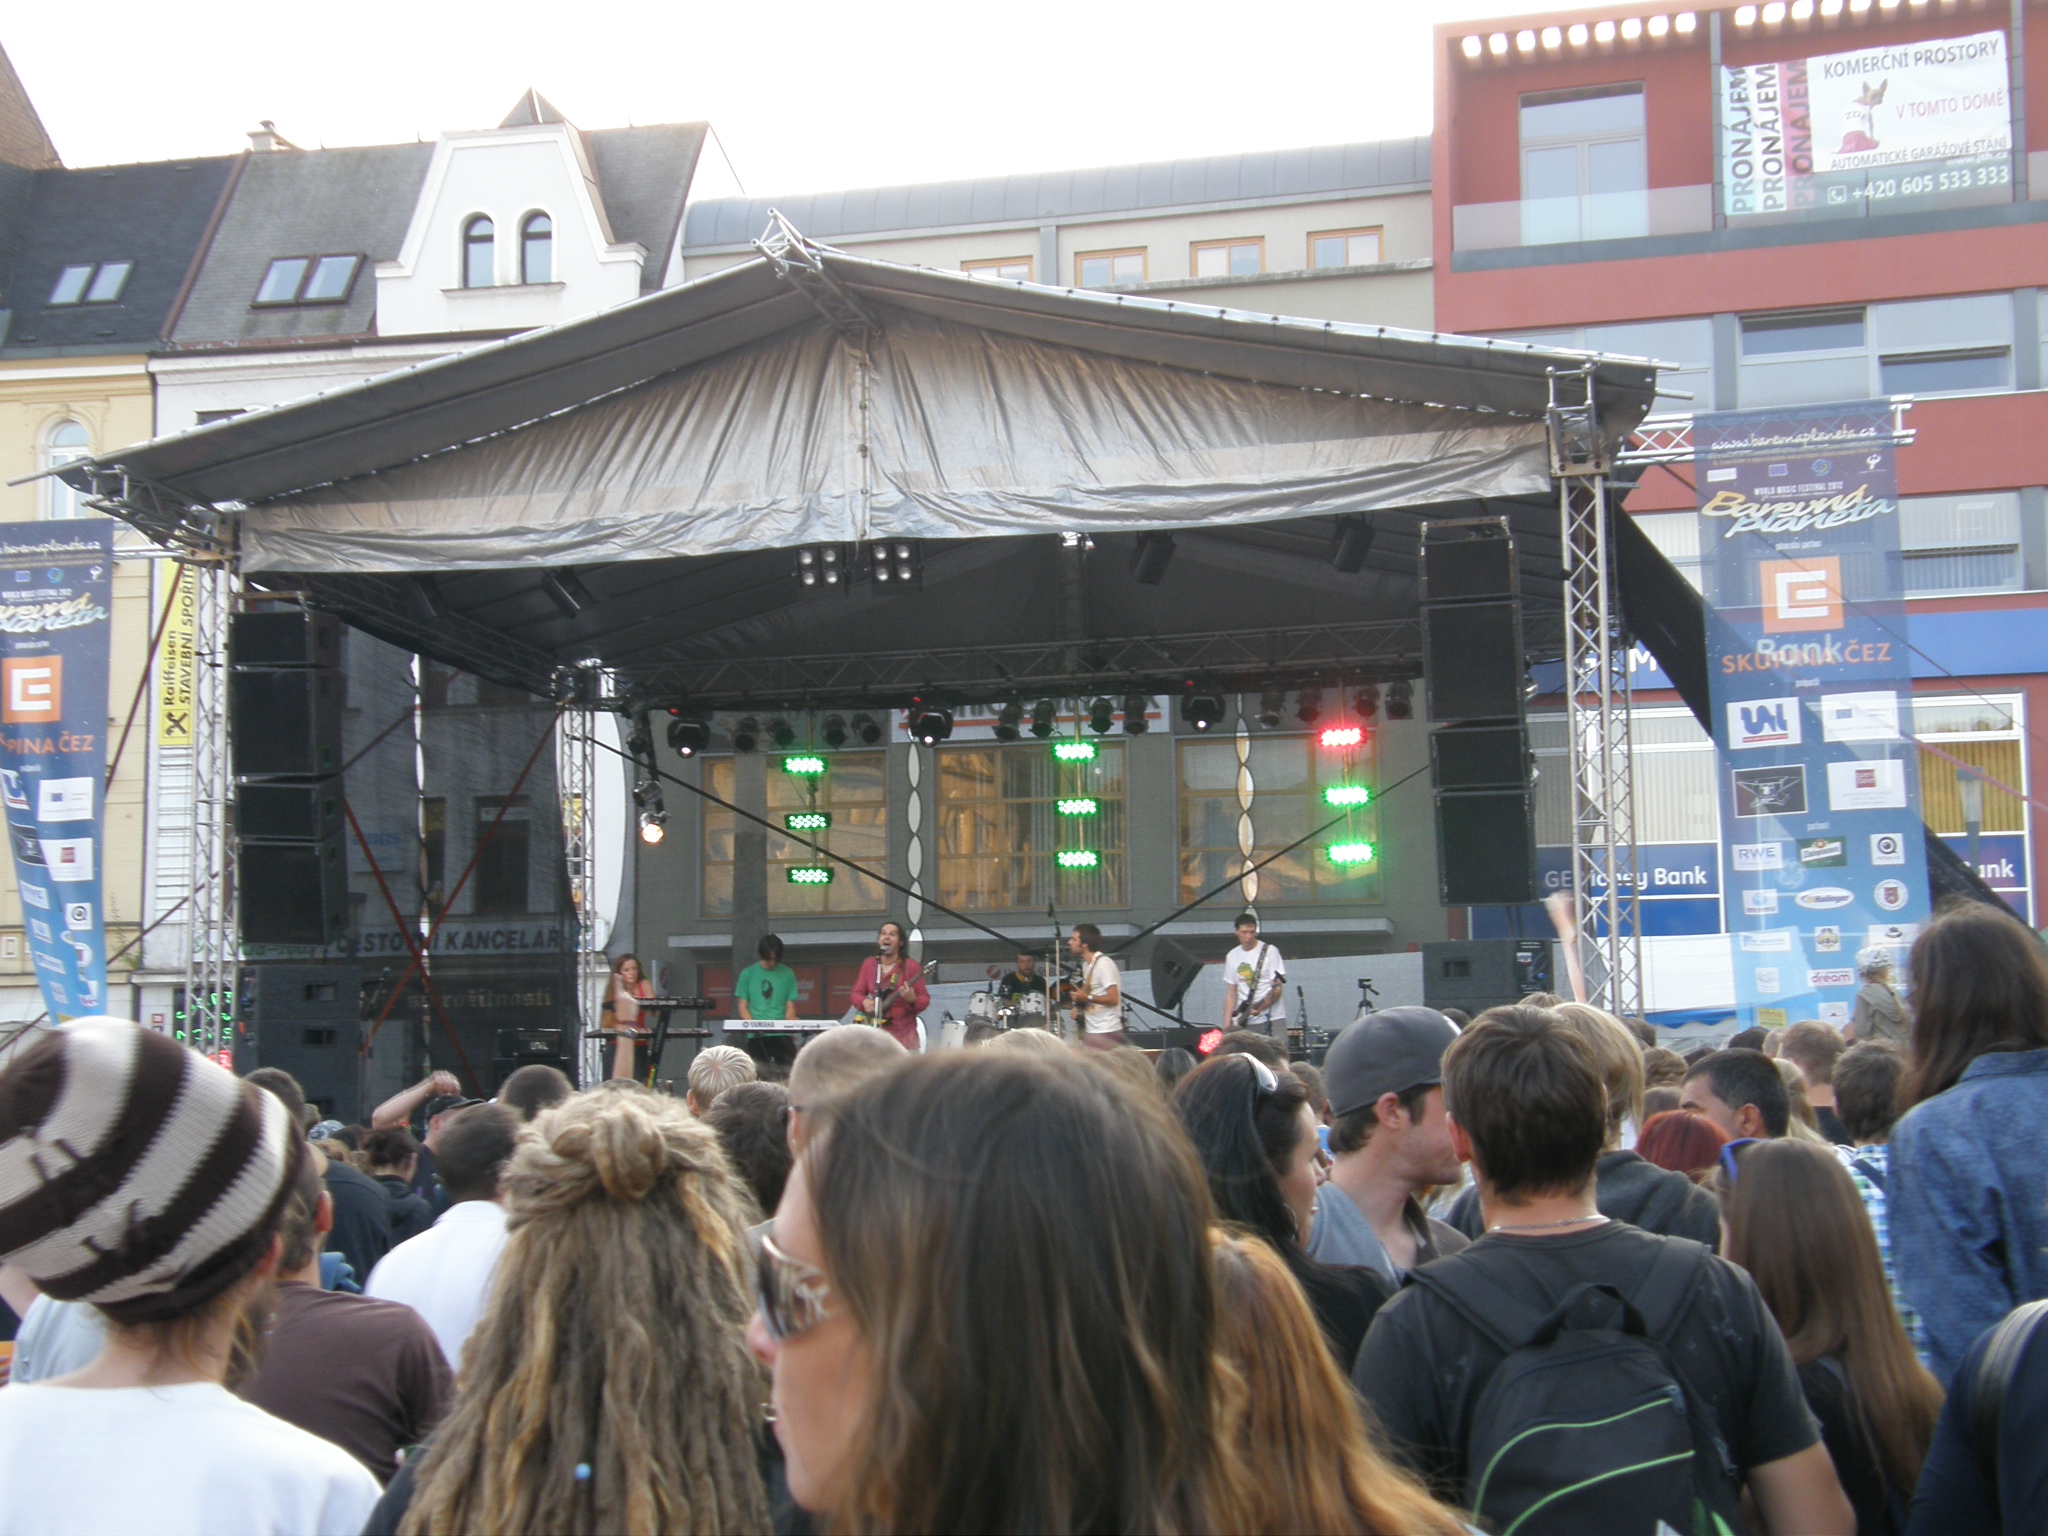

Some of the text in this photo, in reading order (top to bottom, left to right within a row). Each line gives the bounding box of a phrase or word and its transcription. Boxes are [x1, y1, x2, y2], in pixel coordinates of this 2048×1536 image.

[1823, 39, 1999, 79] KOMERČNÍ PROSTORY
[1896, 104, 1906, 119] V
[1909, 97, 1958, 117] TOMTO
[1754, 64, 1784, 211] PRONÁJEM
[1830, 147, 1909, 170] AUTOMATICKÉ
[1911, 138, 1972, 160] GARÁŽOVÉ
[1974, 136, 2007, 153] STÁNÍ
[1852, 165, 2009, 200] +420 605 533 333
[1724, 498, 1896, 538] planeta
[163, 630, 177, 706] Raiffeisen
[178, 631, 193, 706] STAVEBNÍ
[1844, 639, 1892, 664] ČEZ
[58, 730, 94, 753] ČEZ
[1739, 846, 1776, 859] RWE
[1544, 870, 1571, 888] GE
[1654, 866, 1707, 886] Bank
[1811, 971, 1852, 983] dream
